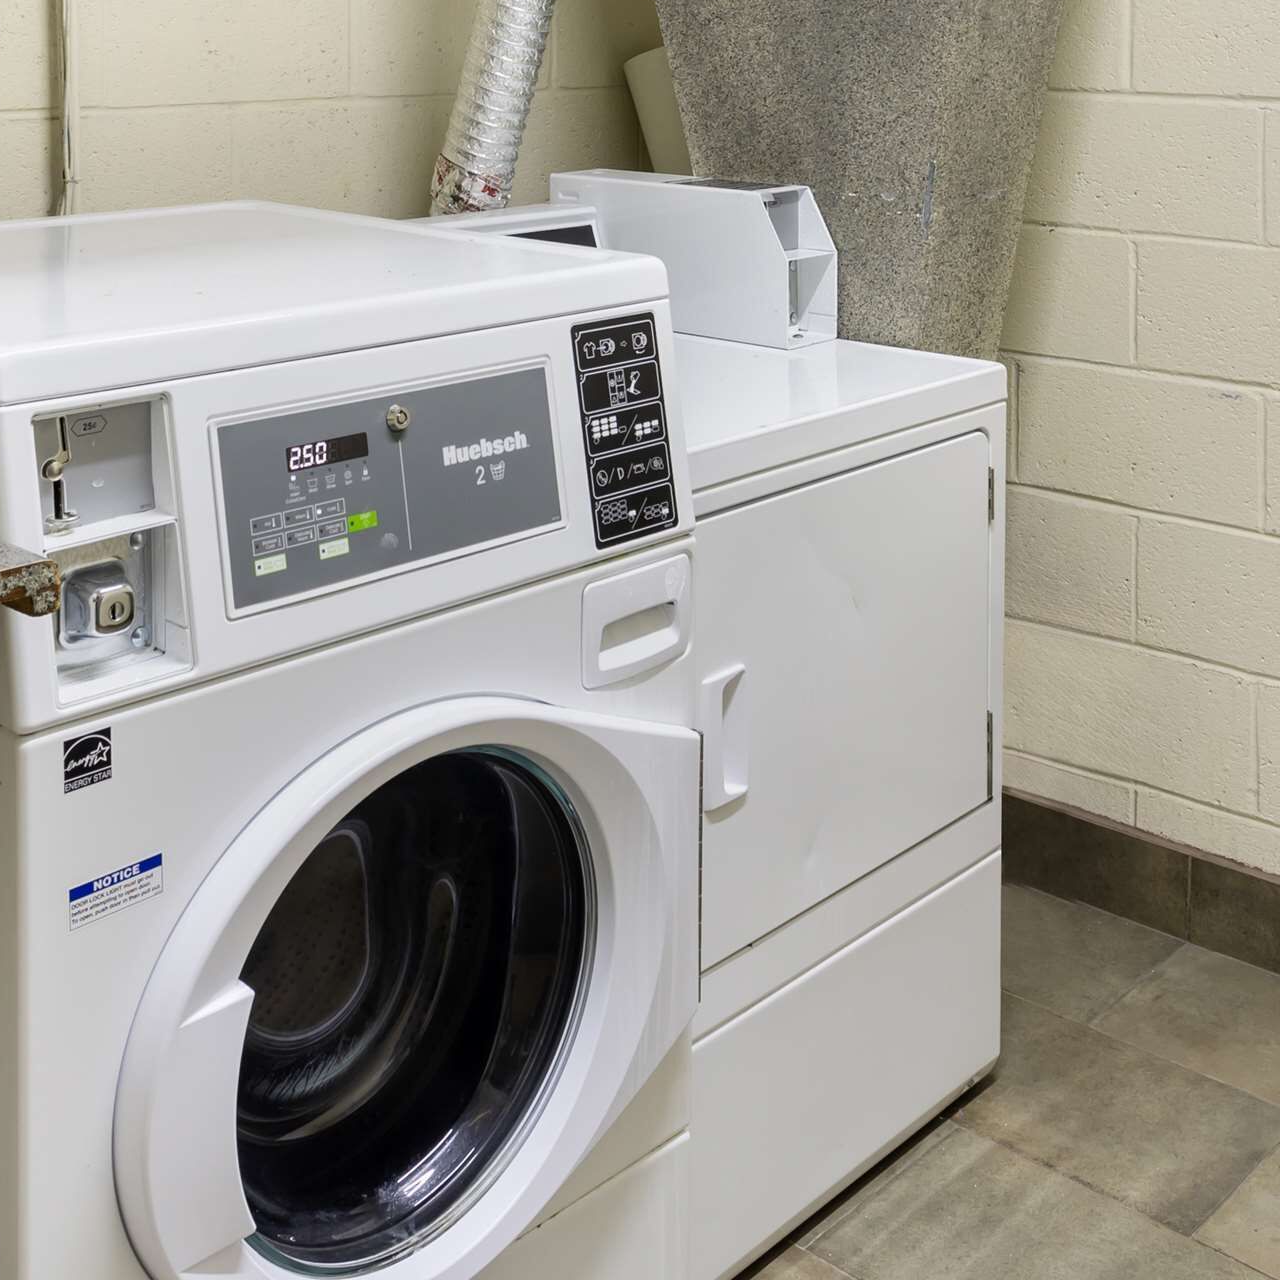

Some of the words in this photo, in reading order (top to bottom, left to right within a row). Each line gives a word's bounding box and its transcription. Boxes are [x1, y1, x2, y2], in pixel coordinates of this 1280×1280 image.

[442, 431, 528, 466] Huebsch
[475, 465, 486, 485] 2
[65, 777, 92, 792] ENERGY
[93, 864, 140, 891] NOTICE
